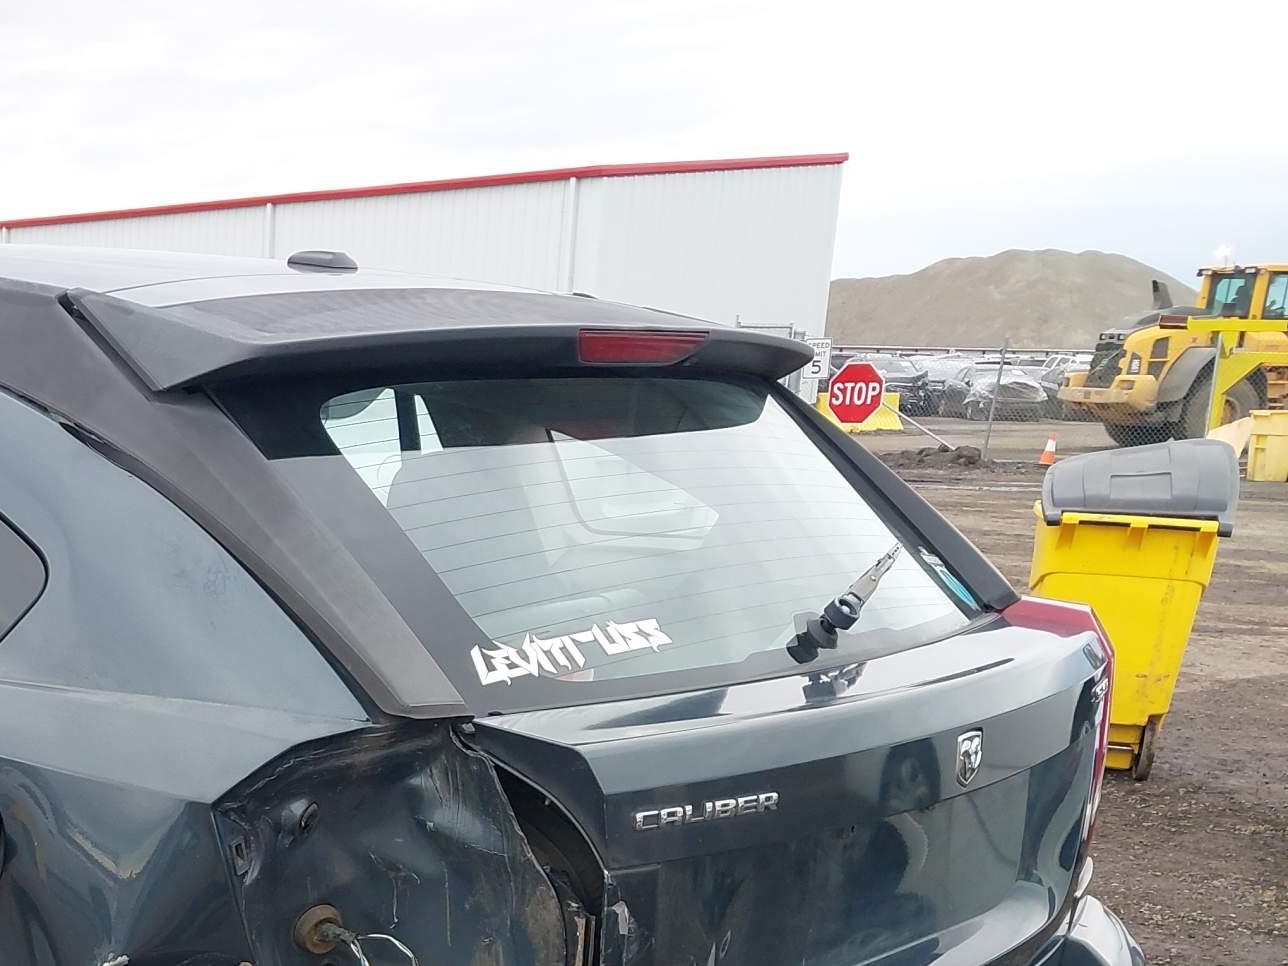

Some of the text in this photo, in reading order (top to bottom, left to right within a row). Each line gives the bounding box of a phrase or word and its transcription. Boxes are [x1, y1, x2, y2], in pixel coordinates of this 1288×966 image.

[811, 360, 822, 375] 5
[831, 381, 881, 407] STOP
[633, 791, 781, 832] CALIBER
